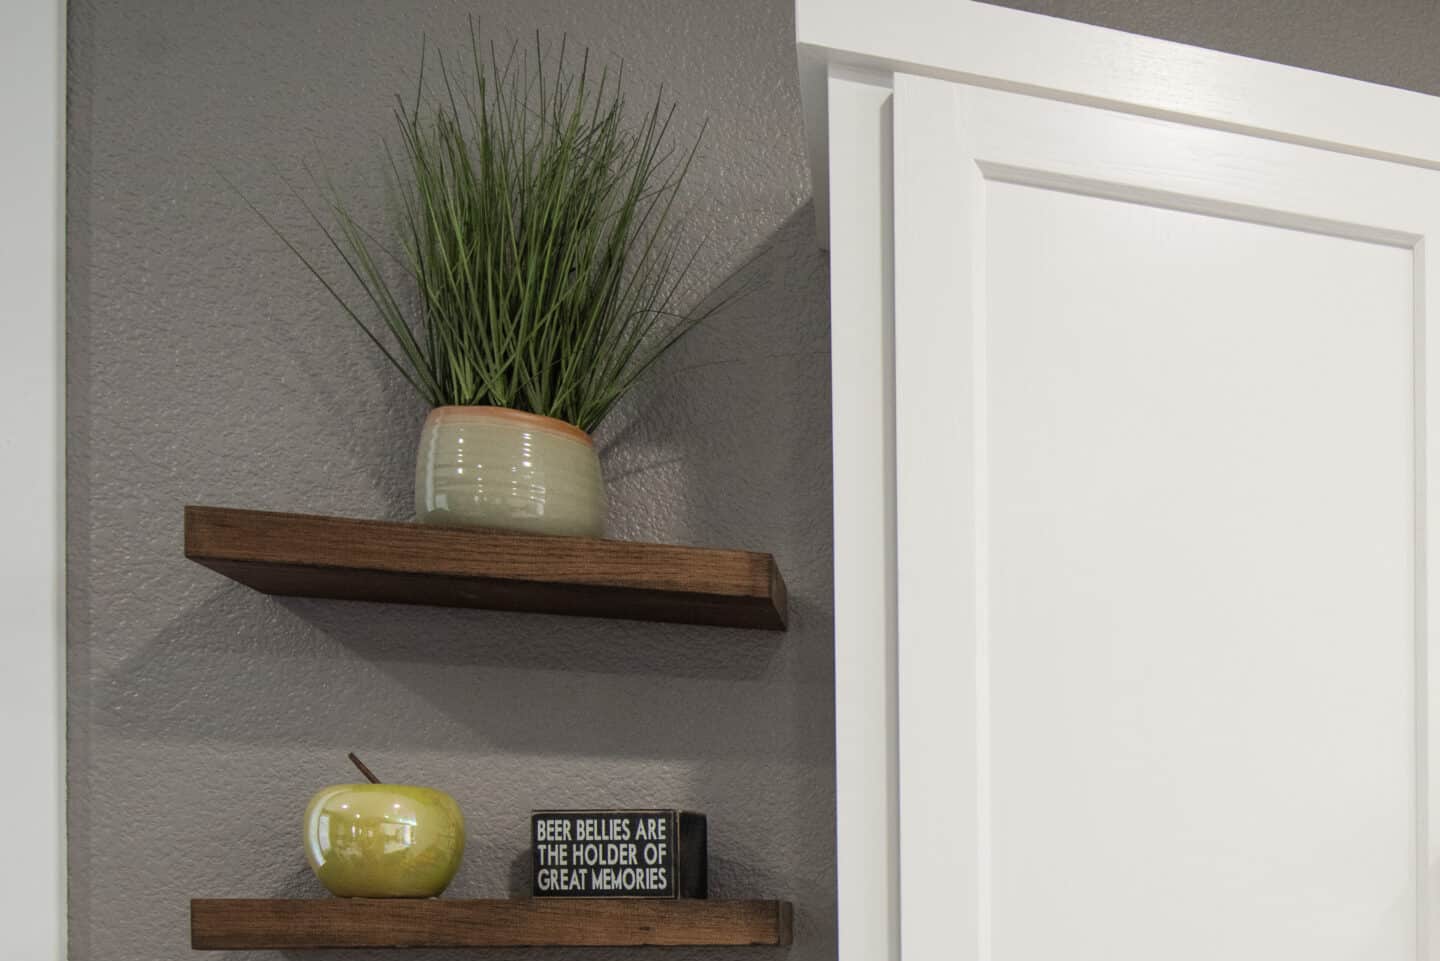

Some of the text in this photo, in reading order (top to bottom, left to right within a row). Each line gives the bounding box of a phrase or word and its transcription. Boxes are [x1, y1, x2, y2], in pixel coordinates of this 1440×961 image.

[537, 817, 667, 841] BEER BELLIES ARE
[537, 842, 667, 866] THE HOLDER OF
[537, 867, 668, 890] GREAT MEMORIES
